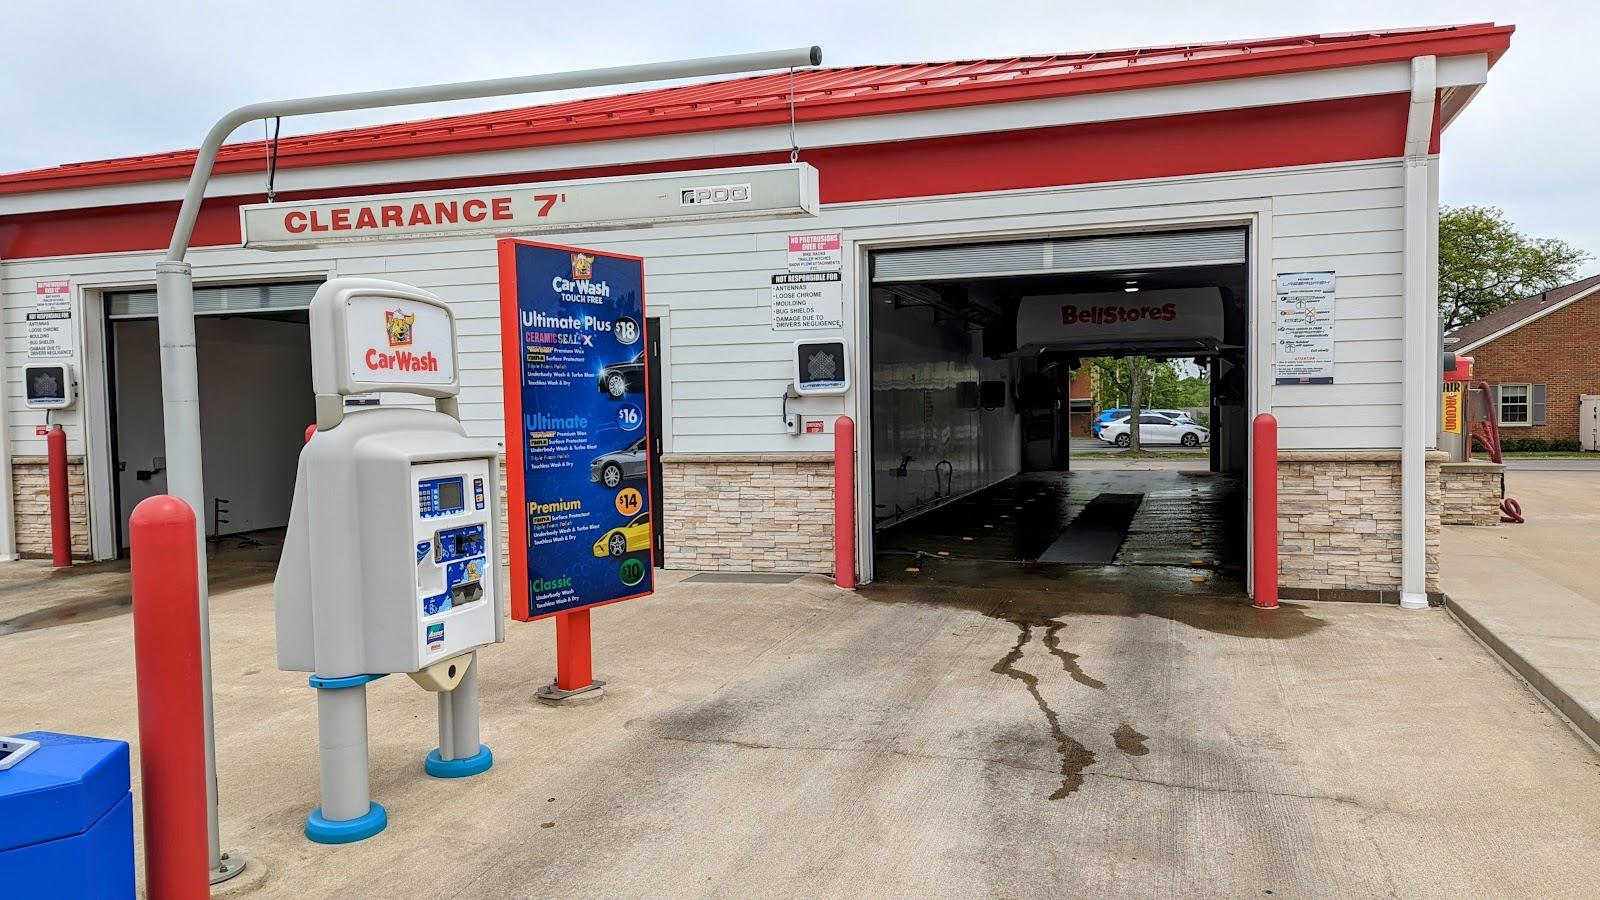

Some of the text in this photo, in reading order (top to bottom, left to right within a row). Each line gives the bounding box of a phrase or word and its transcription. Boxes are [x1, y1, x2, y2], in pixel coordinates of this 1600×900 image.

[696, 186, 748, 204] PDQ
[285, 192, 567, 234] CLEARANCE 7'
[800, 235, 838, 244] PROTRUSIONS
[788, 274, 826, 282] RESPONSIBLE
[561, 294, 603, 304] TOUCH FREE
[523, 310, 611, 332] Ultimate Plus
[616, 322, 635, 339] $18
[1443, 382, 1460, 393] AIR
[619, 408, 638, 424] $16
[1445, 395, 1457, 431] VACUUM
[526, 413, 588, 430] Ultimate
[530, 498, 581, 515] Premium
[620, 494, 637, 508] $14
[622, 564, 640, 578] $10
[533, 574, 572, 592] Classic
[536, 592, 561, 601] Underbody
